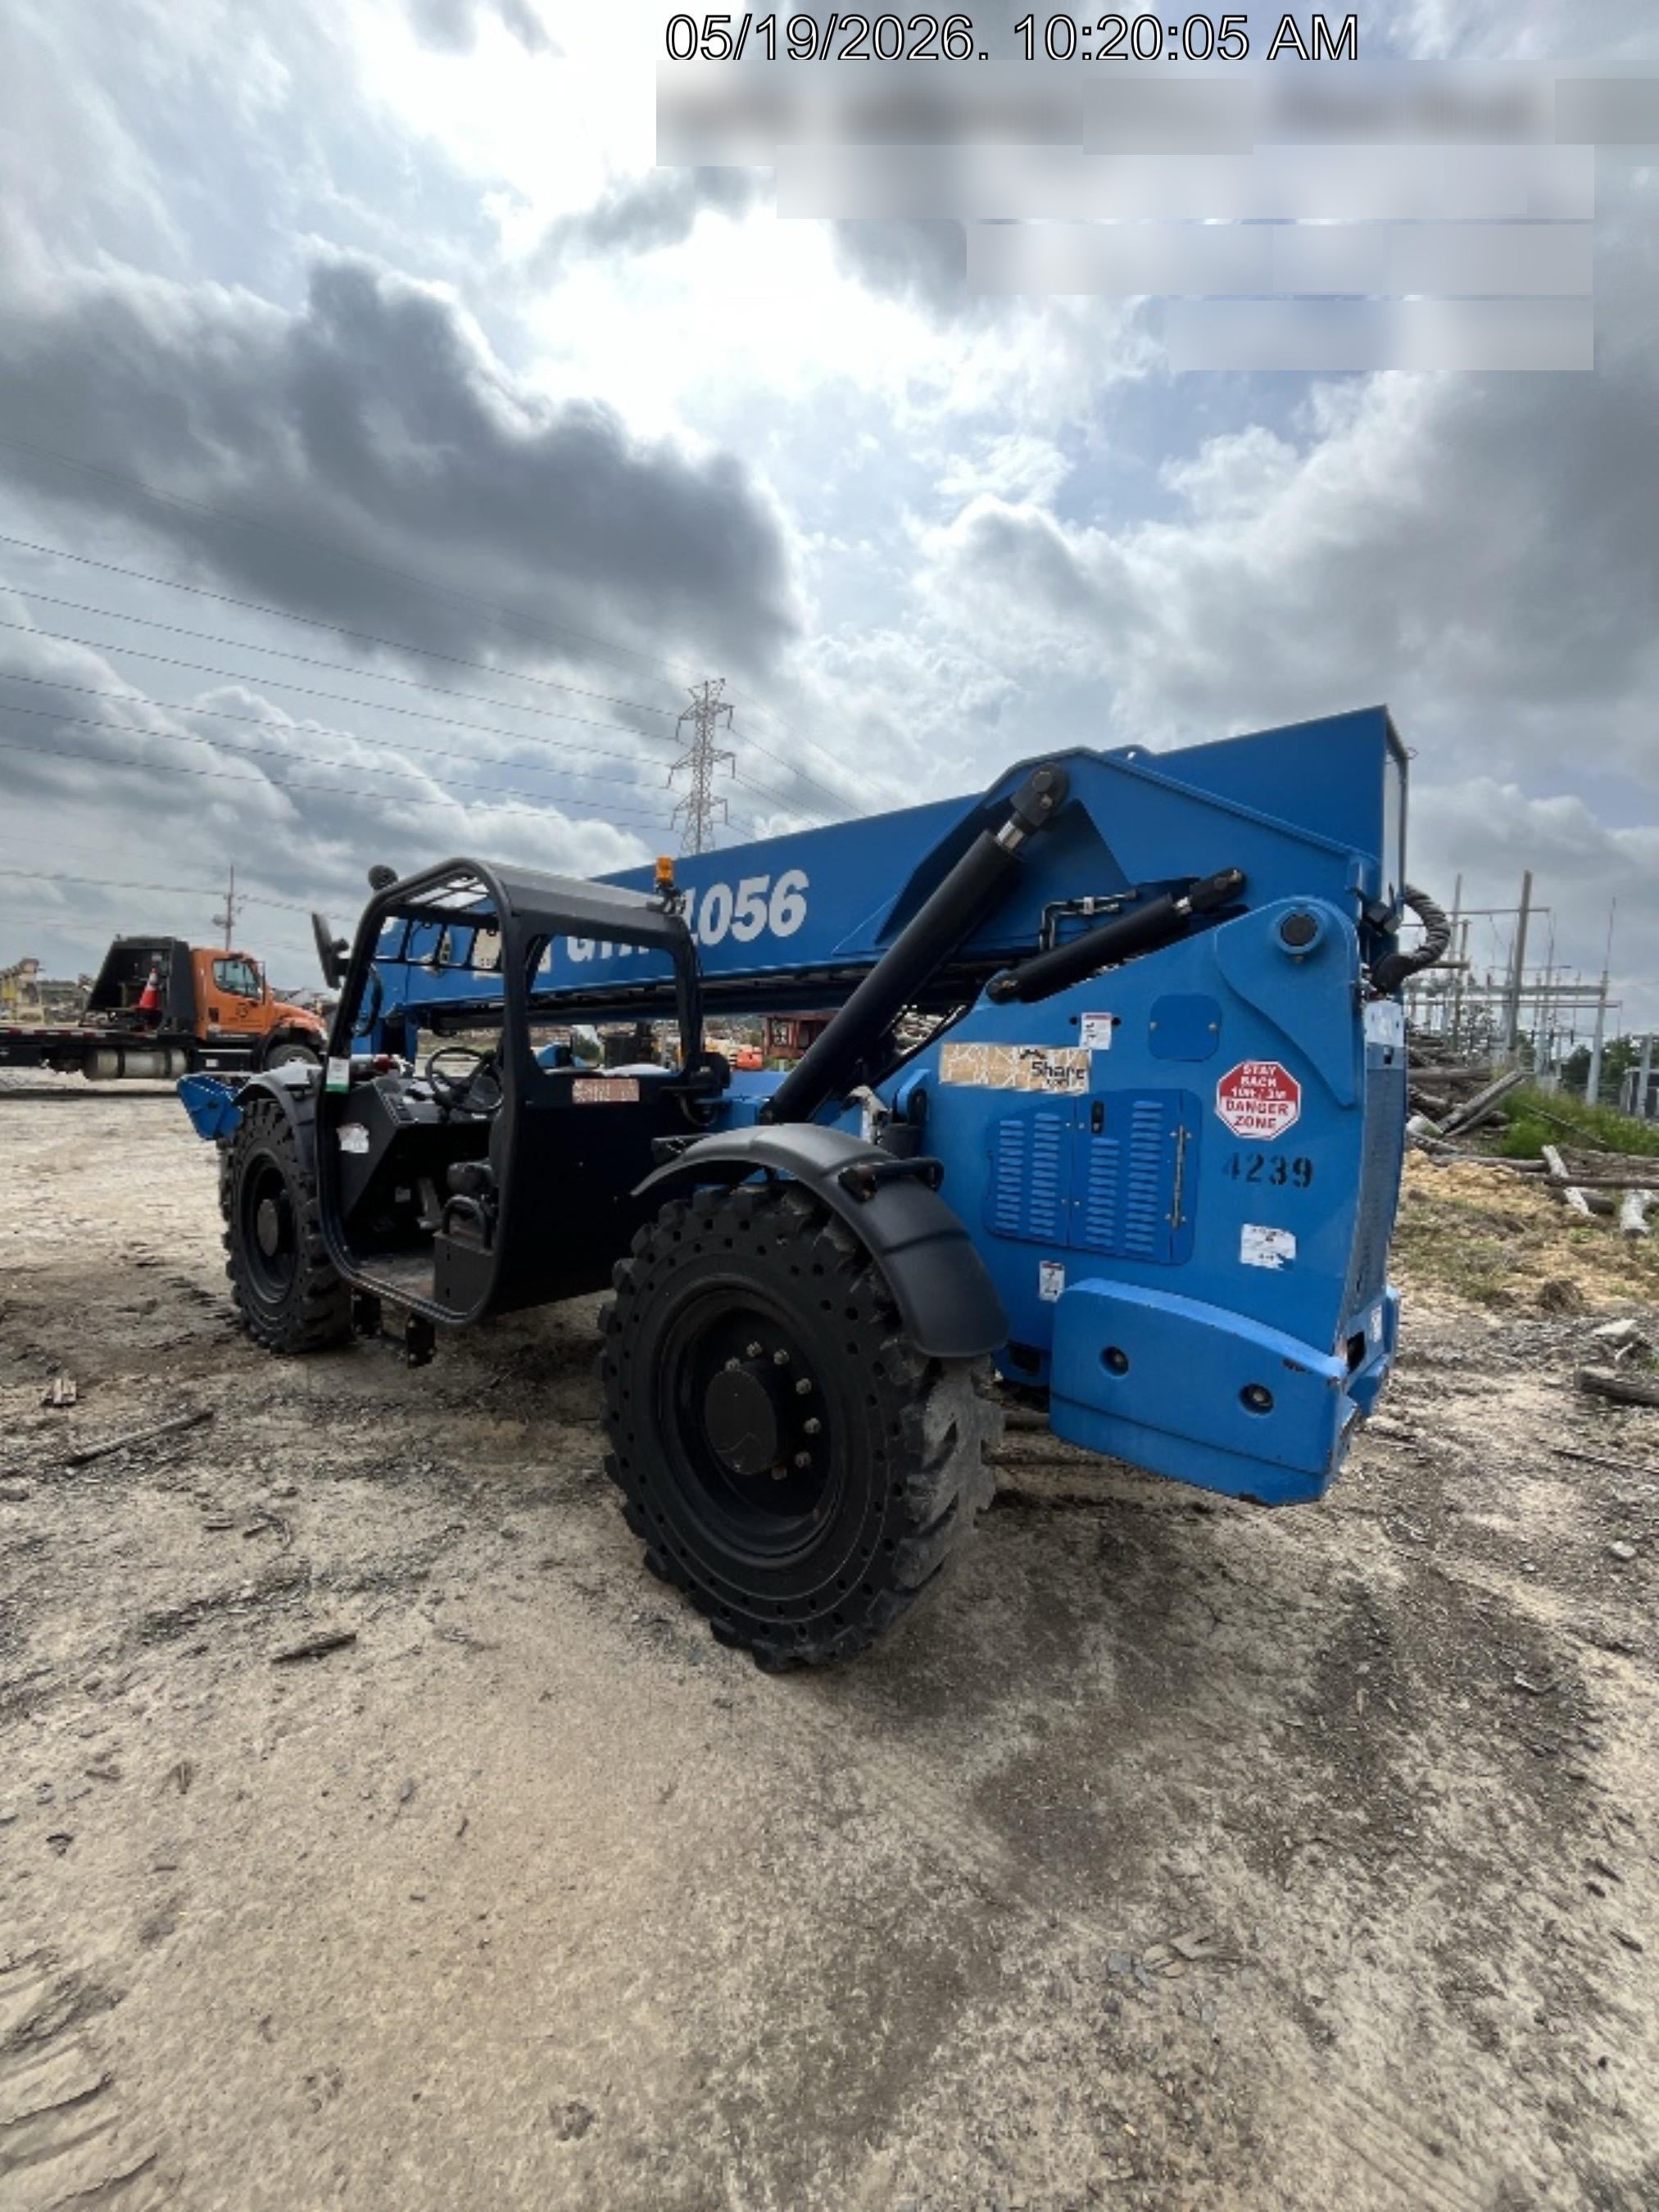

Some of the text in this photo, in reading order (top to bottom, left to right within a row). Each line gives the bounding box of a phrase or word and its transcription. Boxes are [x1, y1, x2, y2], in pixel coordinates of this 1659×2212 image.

[1243, 1065, 1276, 1076] STAY
[1240, 1076, 1276, 1088] BACK
[1226, 1100, 1289, 1115] DANGER
[1235, 1116, 1276, 1129] ZONE
[1222, 1152, 1313, 1188] 4239
